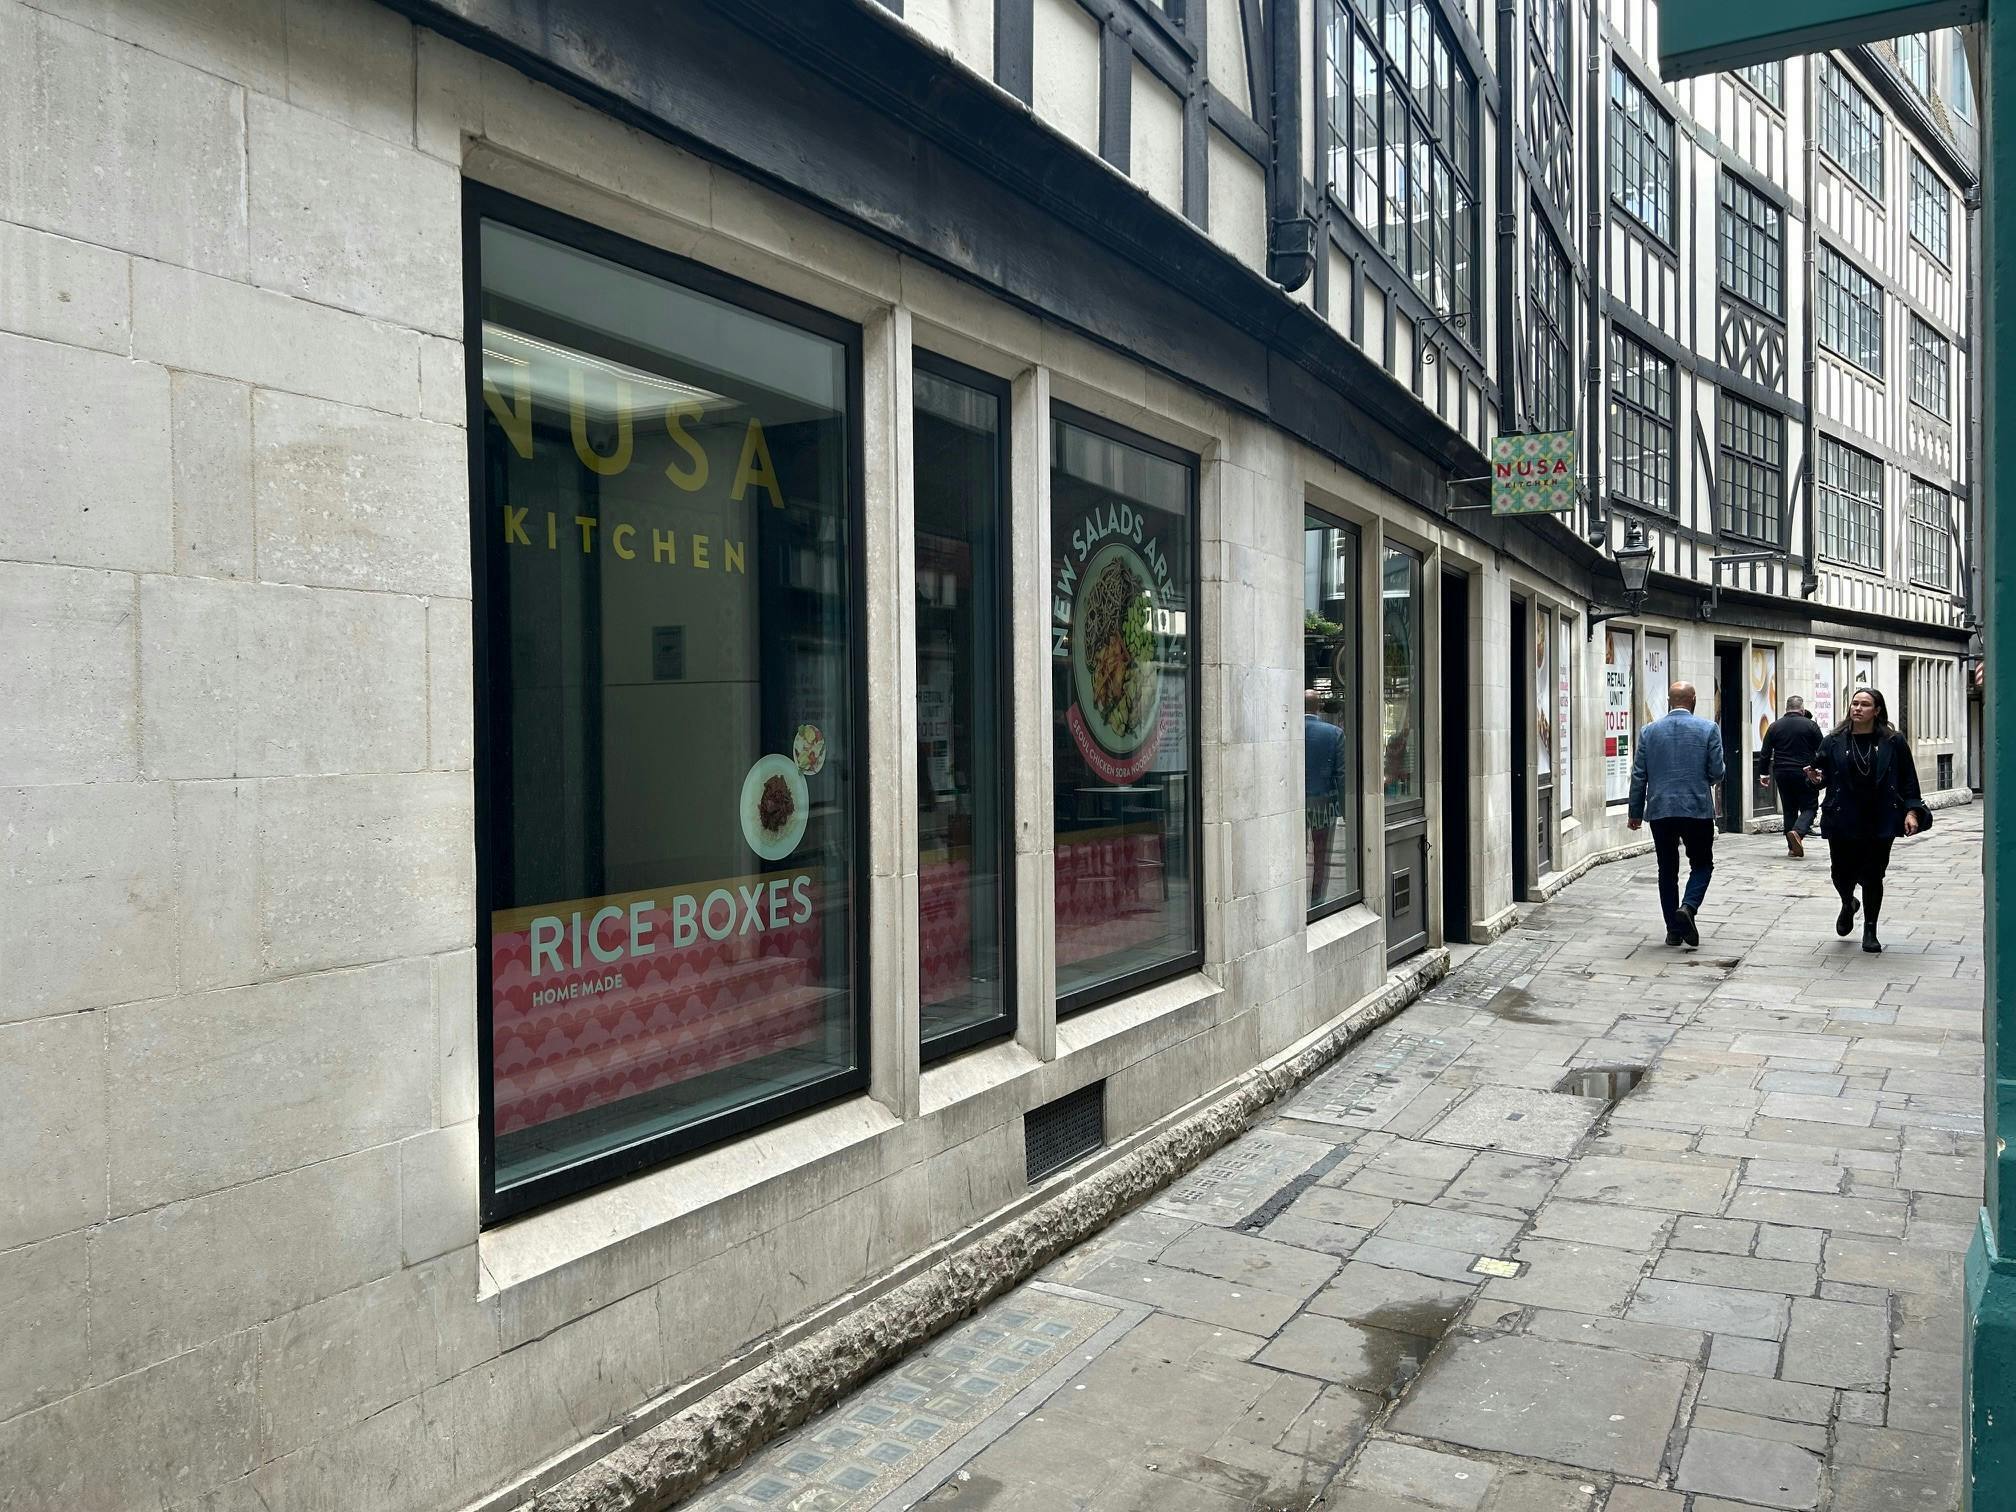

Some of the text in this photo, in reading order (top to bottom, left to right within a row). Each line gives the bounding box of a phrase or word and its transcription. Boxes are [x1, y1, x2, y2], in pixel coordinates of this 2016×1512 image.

[483, 362, 785, 508] NUSA
[1496, 458, 1568, 478] NUSA
[1505, 479, 1558, 489] KITCHEN
[504, 504, 745, 575] KITCHEN
[1053, 503, 1175, 657] NEW SALADS ARE
[1607, 672, 1626, 688] RETAIL
[1609, 691, 1623, 706] UNIT
[1605, 711, 1628, 730] TO LET
[1072, 719, 1154, 778] SEOUL CHICKEN SOBA NOODLE
[531, 875, 813, 977] RICE BOXES
[533, 973, 622, 1008] HOME MADE
